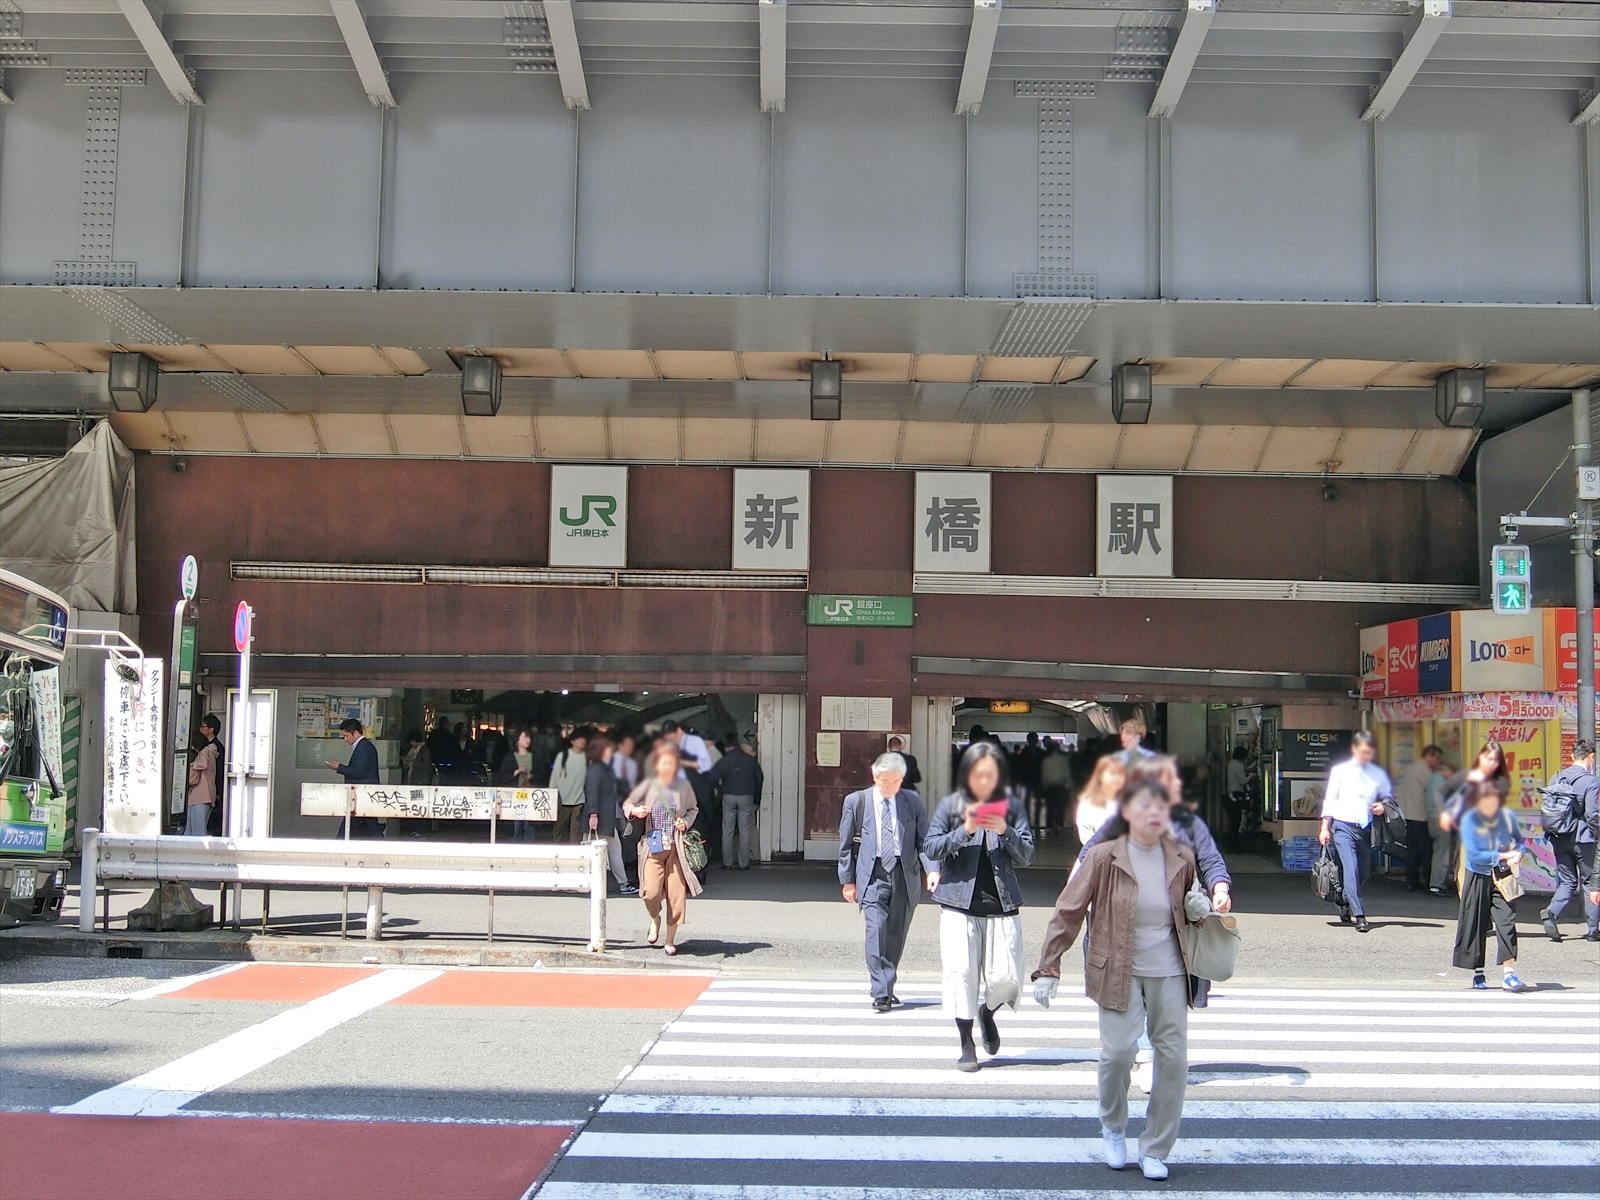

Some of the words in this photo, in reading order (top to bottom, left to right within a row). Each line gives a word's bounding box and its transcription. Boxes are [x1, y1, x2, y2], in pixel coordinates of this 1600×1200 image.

[559, 495, 617, 527] JR
[566, 528, 610, 538] JR東日本
[187, 561, 193, 582] 2
[824, 600, 853, 616] JR
[856, 600, 882, 609] 銀座口
[1389, 644, 1417, 673] 宝くじ
[1420, 638, 1449, 663] NUMBERS
[1470, 639, 1507, 662] LOTO
[150, 669, 159, 773] タクシー乗務員の皆さんへ
[119, 676, 130, 806] 停車はご遠慮下さい。
[1297, 733, 1339, 742] KIOSK
[515, 791, 529, 800] 24K
[2, 829, 44, 846] ノンステップバス
[15, 877, 35, 897] 15-85
